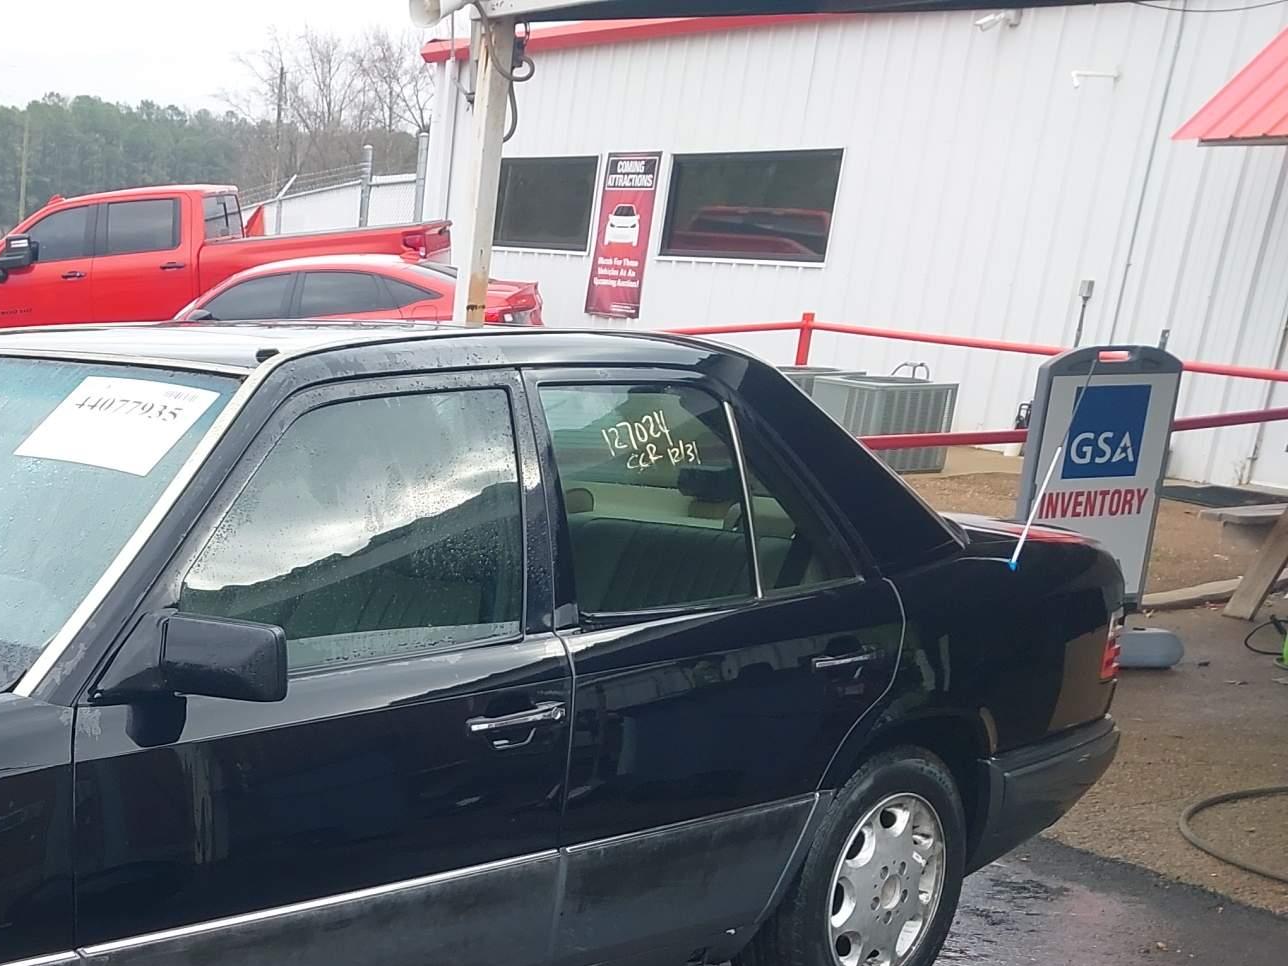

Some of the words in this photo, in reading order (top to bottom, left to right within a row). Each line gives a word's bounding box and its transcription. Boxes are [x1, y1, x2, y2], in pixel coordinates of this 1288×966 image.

[617, 160, 645, 173] COMING
[607, 174, 654, 187] ATTRACTIONS
[75, 396, 184, 421] 44077935
[601, 410, 673, 457] 127024
[667, 440, 701, 466] 12/31
[1070, 431, 1134, 464] GSA
[1038, 488, 1149, 520] INVENTORY
